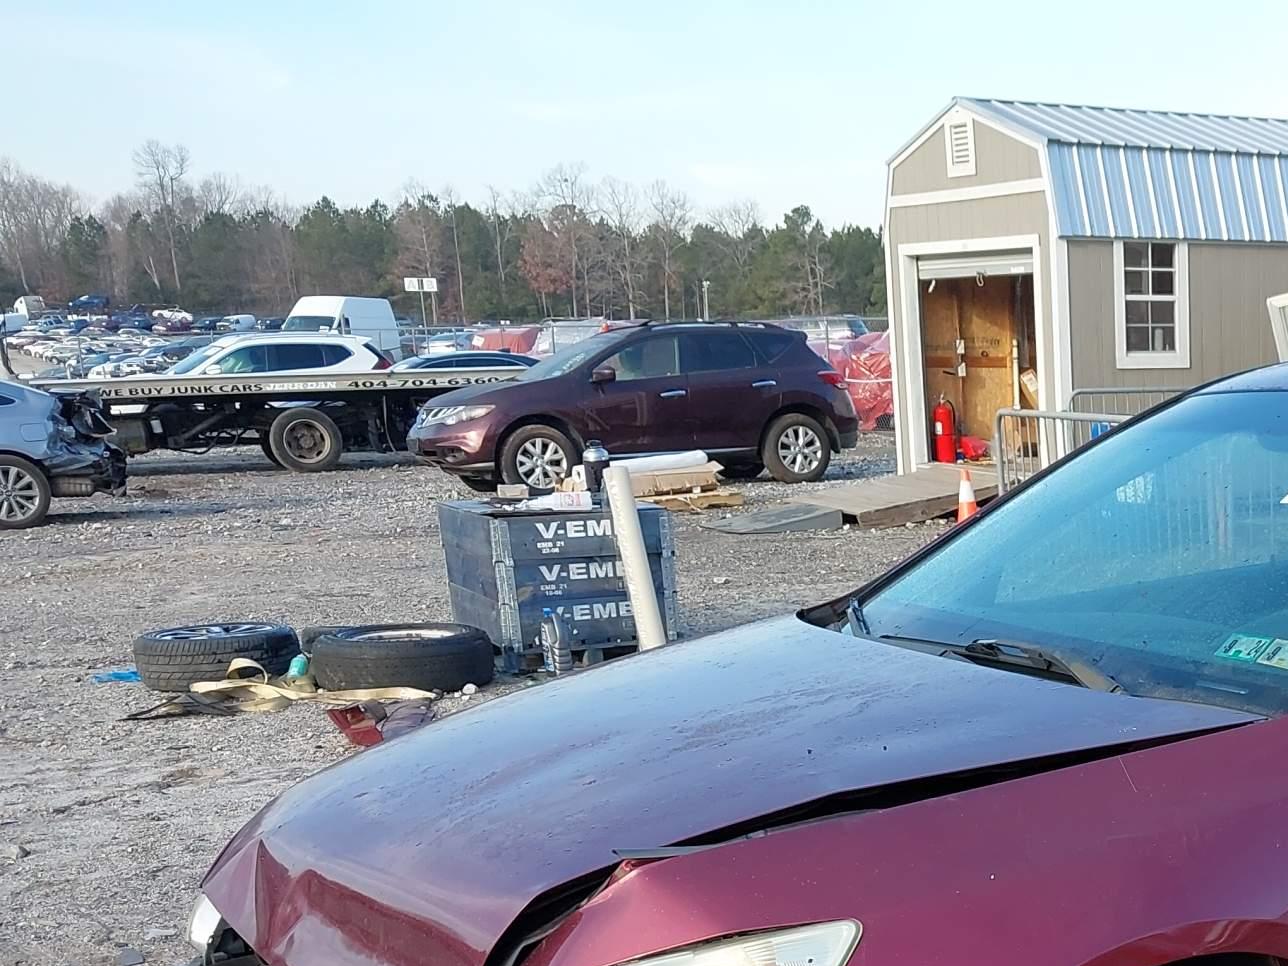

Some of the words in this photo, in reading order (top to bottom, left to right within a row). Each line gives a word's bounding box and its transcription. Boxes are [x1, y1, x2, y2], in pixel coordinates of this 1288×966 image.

[100, 388, 124, 398] WE
[128, 387, 164, 396] BUY
[168, 385, 214, 395] JUNK
[219, 383, 264, 393] CARS
